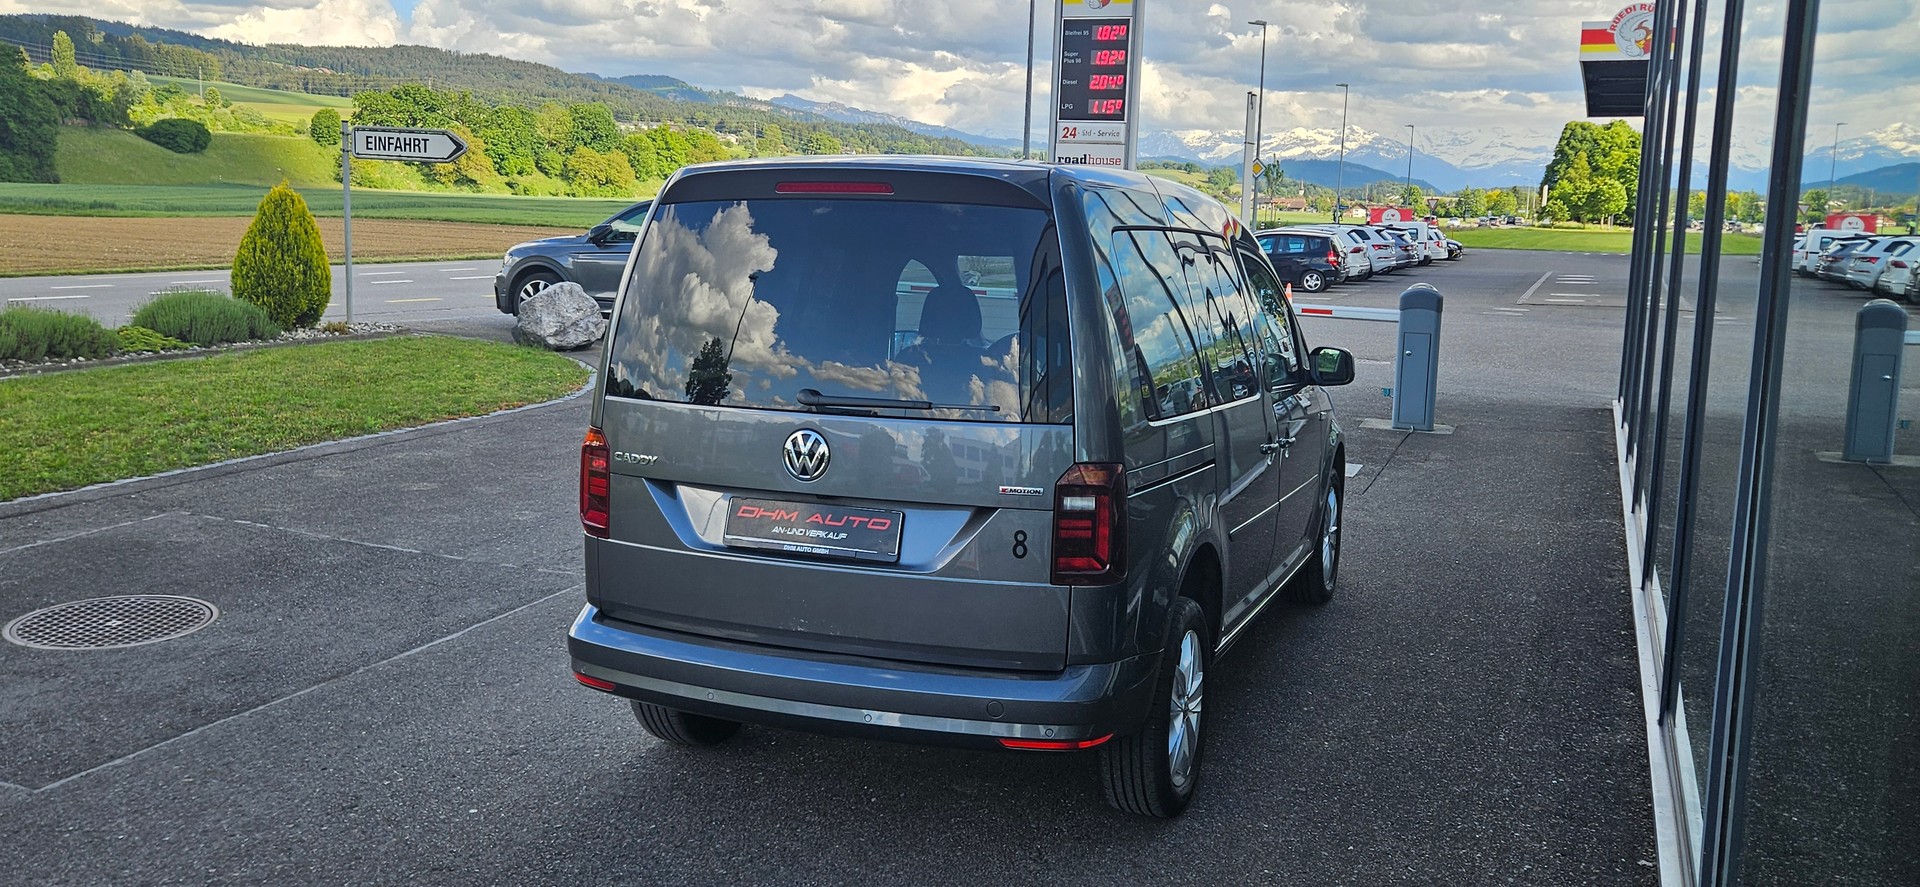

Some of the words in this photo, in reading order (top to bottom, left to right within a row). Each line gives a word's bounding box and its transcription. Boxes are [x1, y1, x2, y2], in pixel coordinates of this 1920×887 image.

[1609, 5, 1637, 31] RUEDI
[1062, 126, 1077, 139] 24
[1097, 129, 1120, 137] Service
[365, 135, 429, 153] EINFAHRT
[1057, 154, 1121, 166] roadhouse
[613, 451, 659, 466] CADDY
[736, 505, 799, 522] DHM
[805, 513, 892, 530] AUTO
[805, 530, 848, 540] VERKAUF
[1012, 529, 1028, 559] 8
